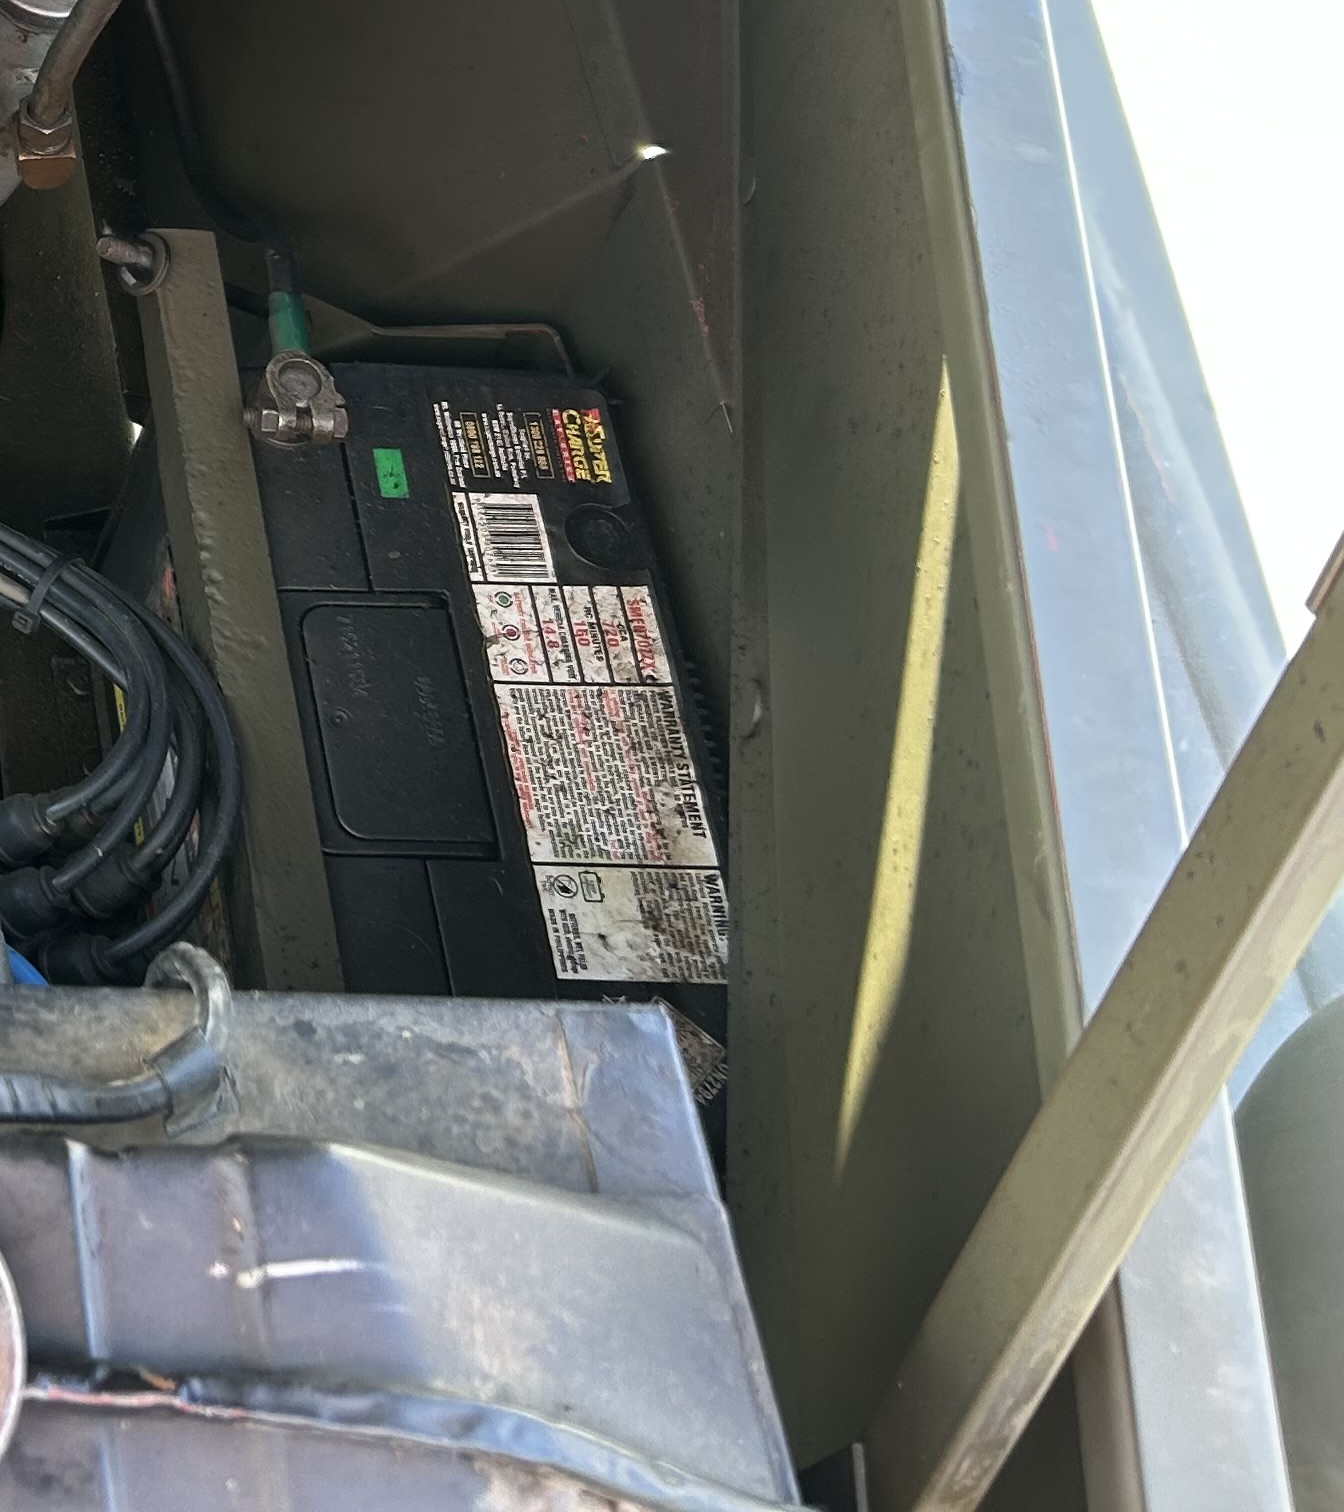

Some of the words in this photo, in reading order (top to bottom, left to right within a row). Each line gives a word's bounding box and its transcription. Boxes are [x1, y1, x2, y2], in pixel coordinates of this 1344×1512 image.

[560, 409, 591, 480] CHARGE
[541, 618, 560, 648] 14.8
[586, 621, 605, 662] MINUTES
[601, 620, 620, 646] 720
[615, 622, 628, 642] CCA
[656, 690, 688, 759] WARRANTY
[674, 762, 707, 838] STATEMENT
